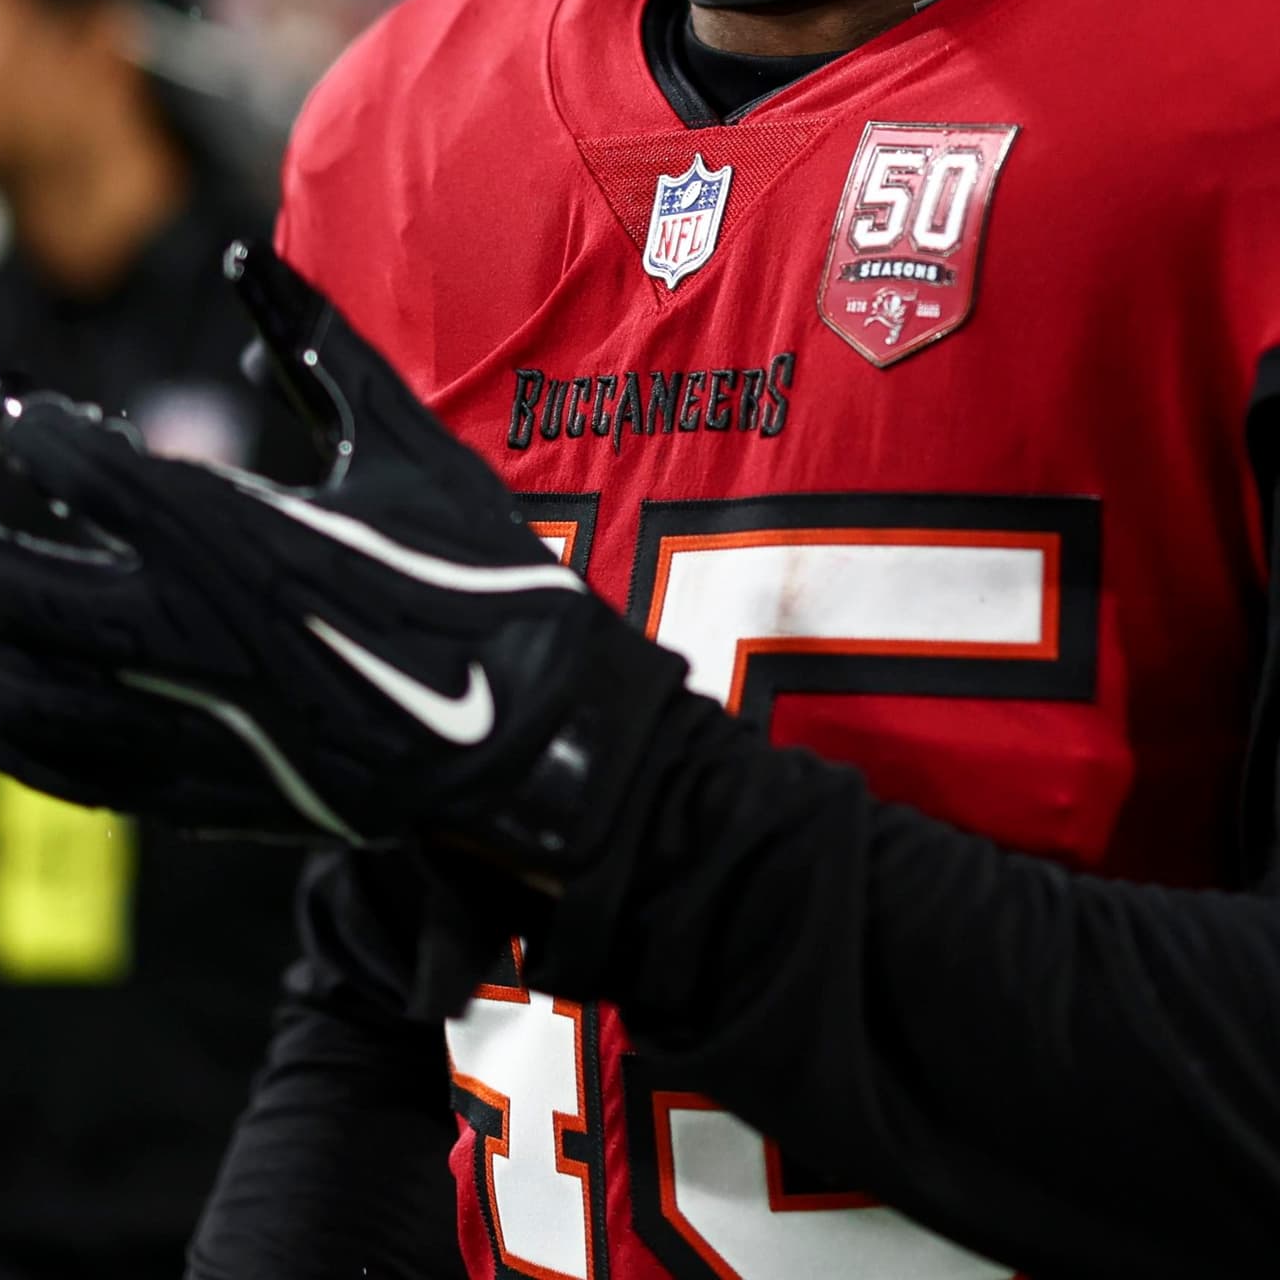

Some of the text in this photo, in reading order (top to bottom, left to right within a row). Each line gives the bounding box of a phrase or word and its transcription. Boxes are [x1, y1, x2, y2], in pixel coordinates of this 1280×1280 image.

[655, 213, 705, 263] NFL
[849, 144, 984, 256] 50
[859, 261, 938, 282] SEASONS
[508, 352, 795, 456] BUCCANEERS
